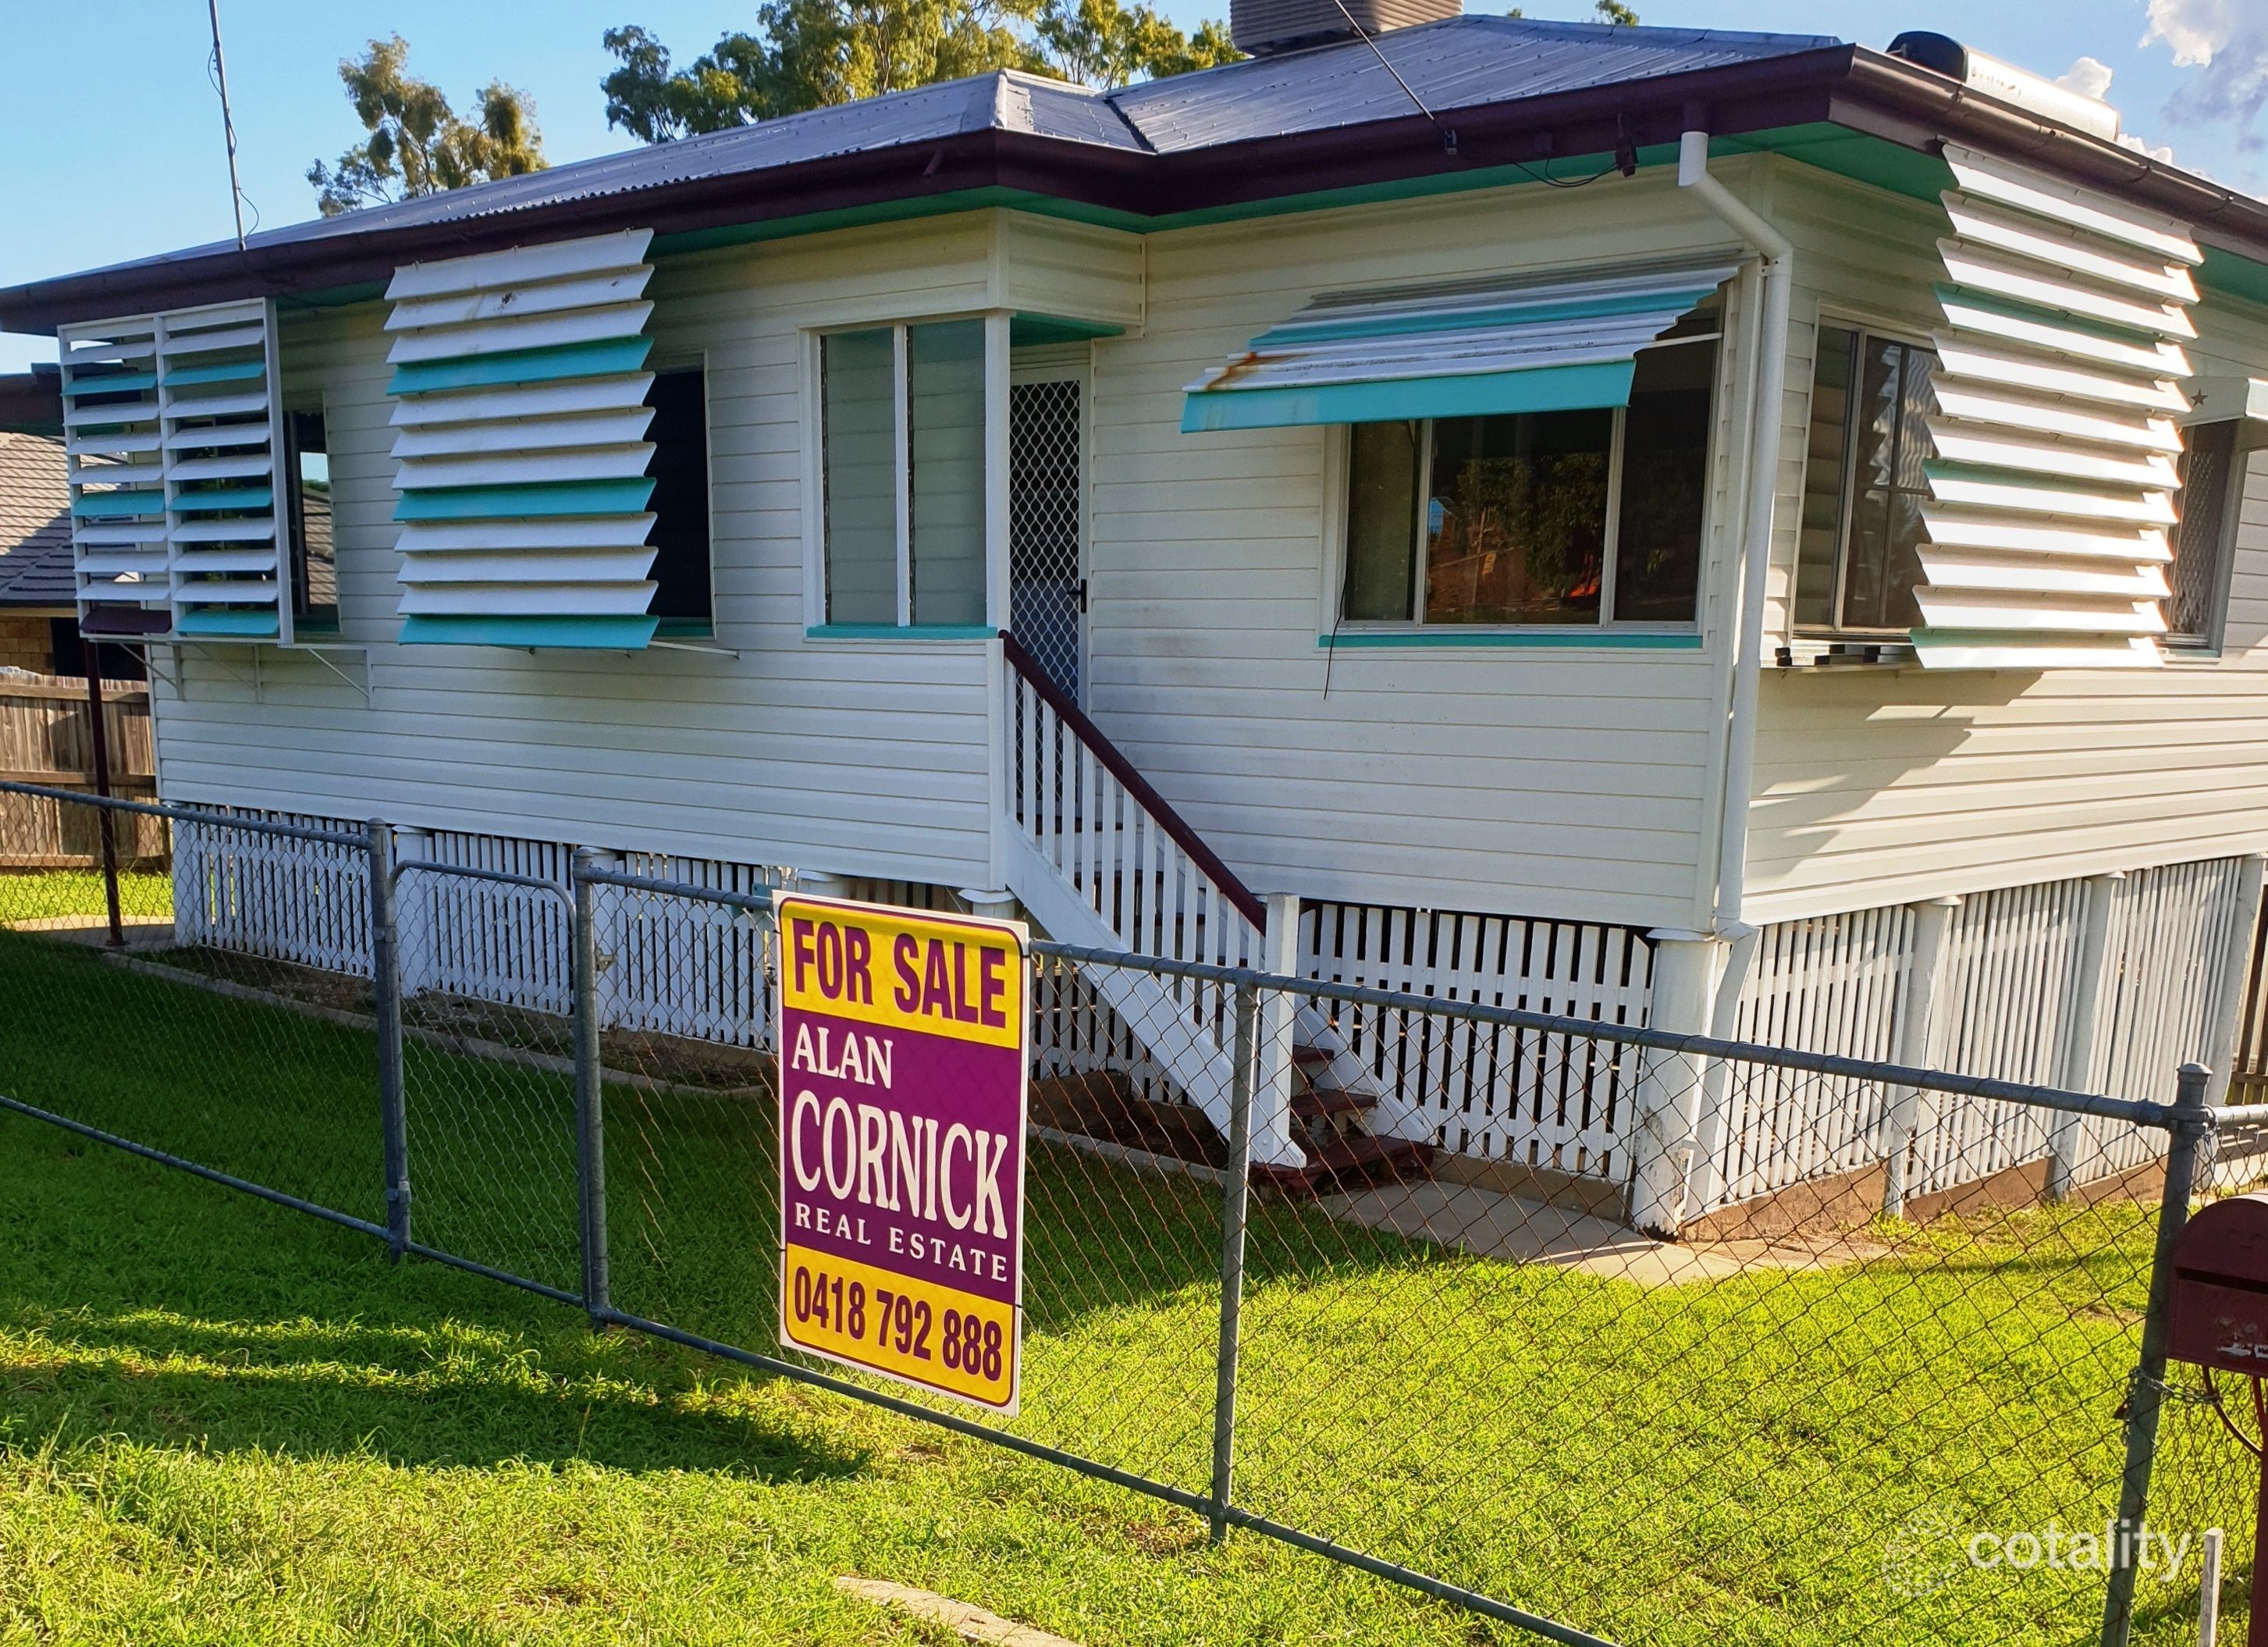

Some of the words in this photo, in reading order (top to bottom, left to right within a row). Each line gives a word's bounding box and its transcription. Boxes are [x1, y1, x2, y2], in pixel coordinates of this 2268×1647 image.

[792, 918, 873, 1005] FOR
[894, 933, 1006, 1029] SALE
[791, 1023, 893, 1089] ALAN
[791, 1090, 1008, 1240] CORNICK
[795, 1202, 871, 1245] REAL
[889, 1227, 1008, 1282] ESTATE
[795, 1266, 866, 1339] 0418
[876, 1289, 932, 1361] 792
[943, 1308, 1002, 1382] 888
